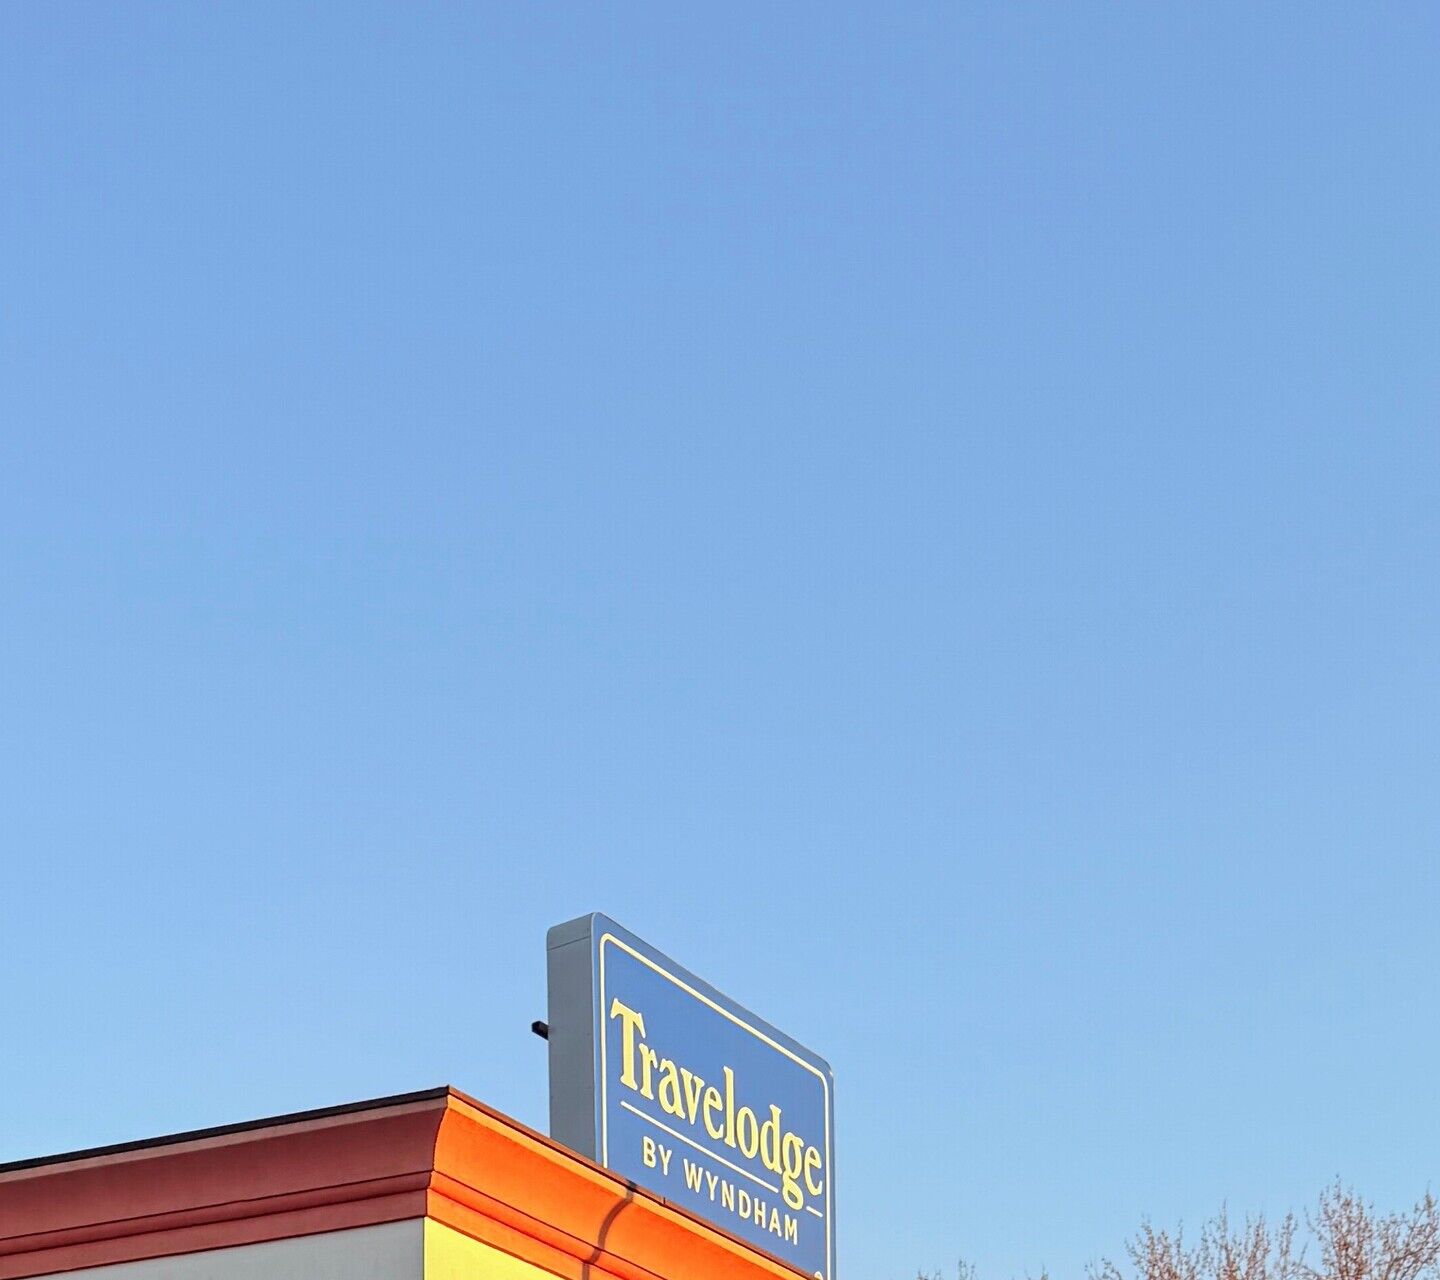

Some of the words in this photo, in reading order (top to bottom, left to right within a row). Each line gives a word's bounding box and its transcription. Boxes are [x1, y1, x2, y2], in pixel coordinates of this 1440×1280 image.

[610, 997, 823, 1210] Travelodge
[642, 1136, 672, 1175] BY
[683, 1158, 798, 1245] WYNDHAM
